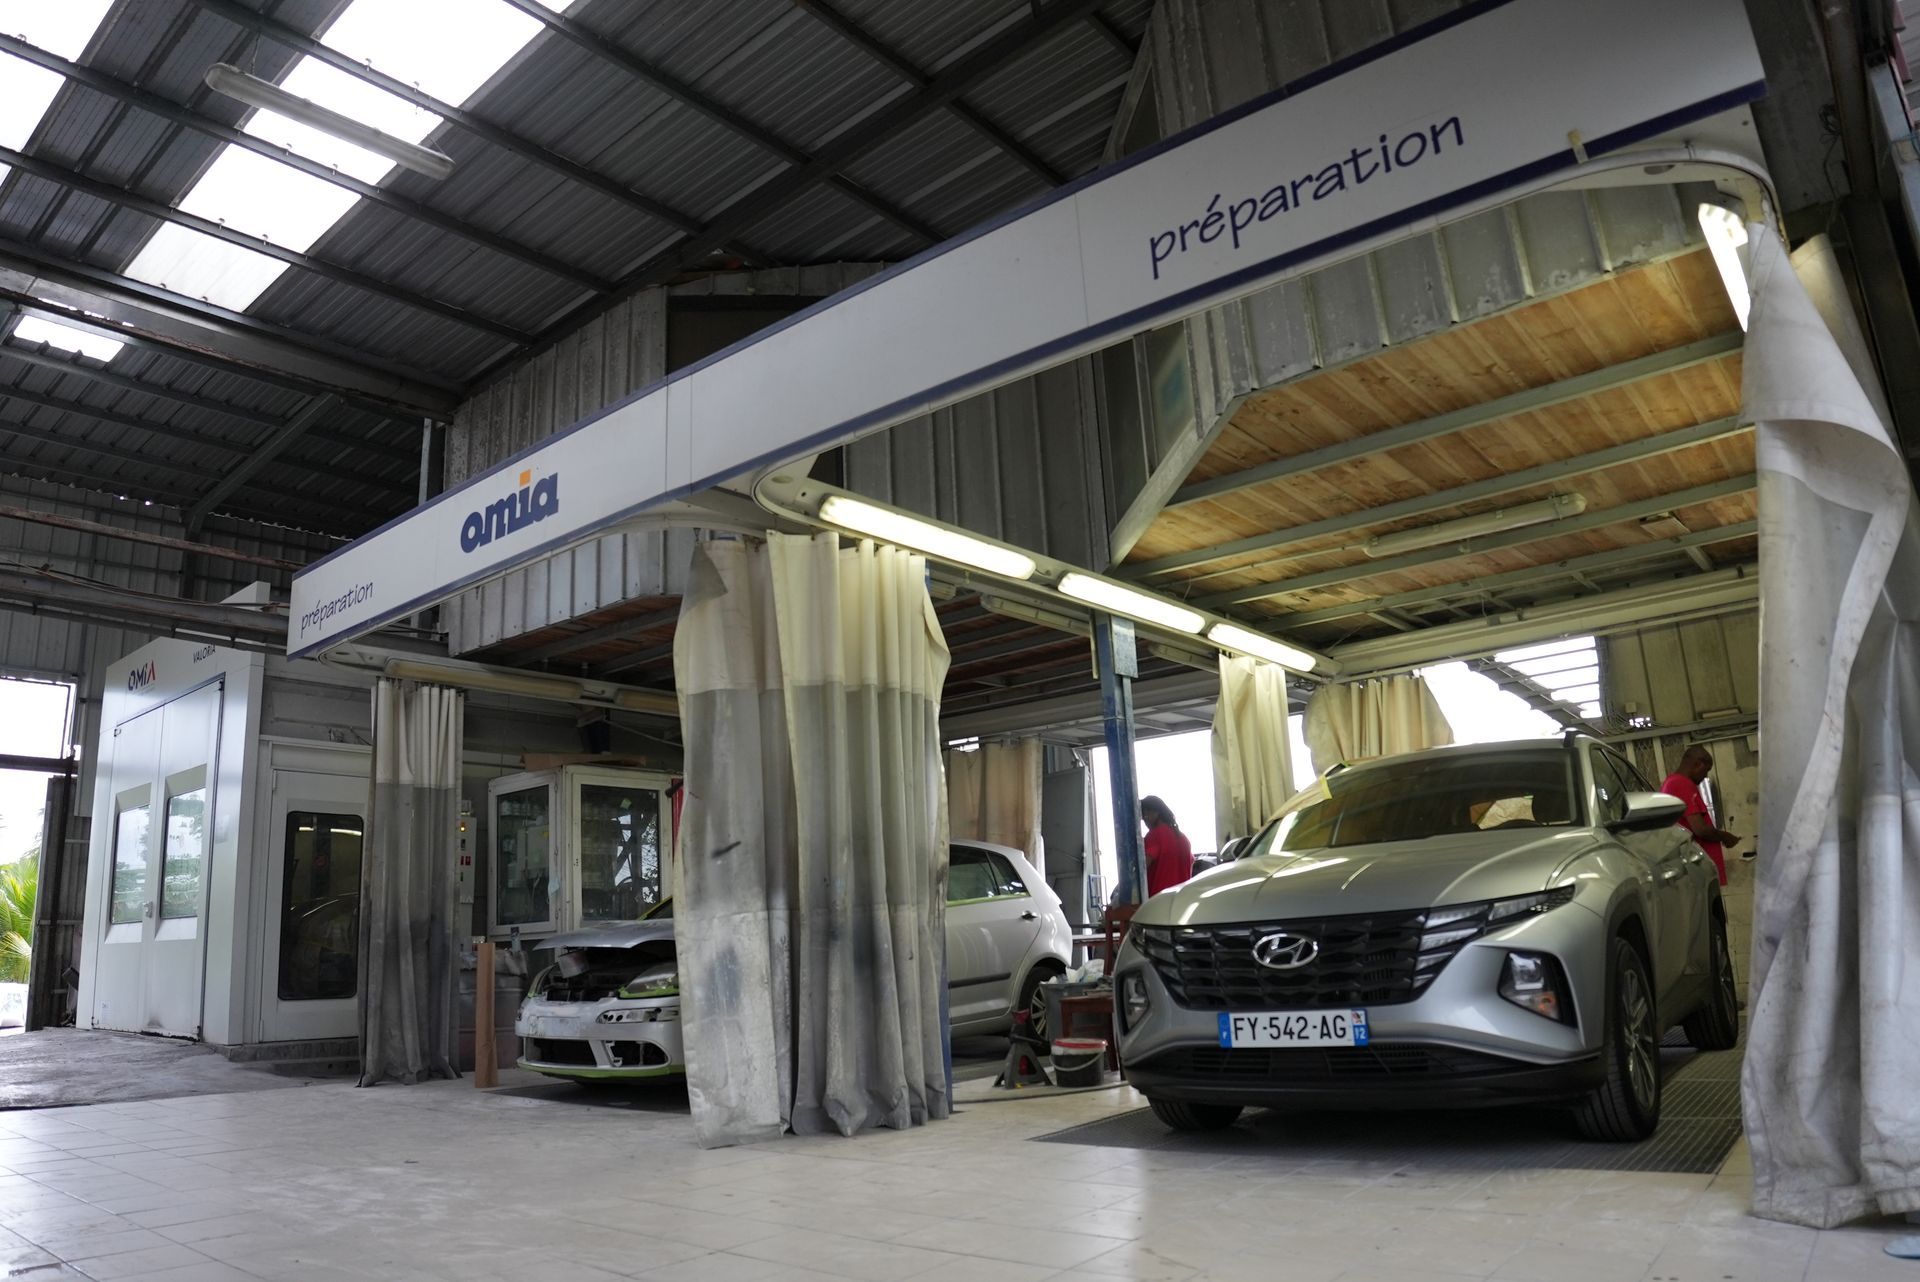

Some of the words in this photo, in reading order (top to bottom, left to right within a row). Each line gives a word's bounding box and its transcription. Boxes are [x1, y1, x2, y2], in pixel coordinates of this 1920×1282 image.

[1150, 116, 1464, 280] préparation
[460, 469, 559, 553] omia
[300, 582, 374, 639] préparation
[1233, 1015, 1347, 1041] FY-542-AG
